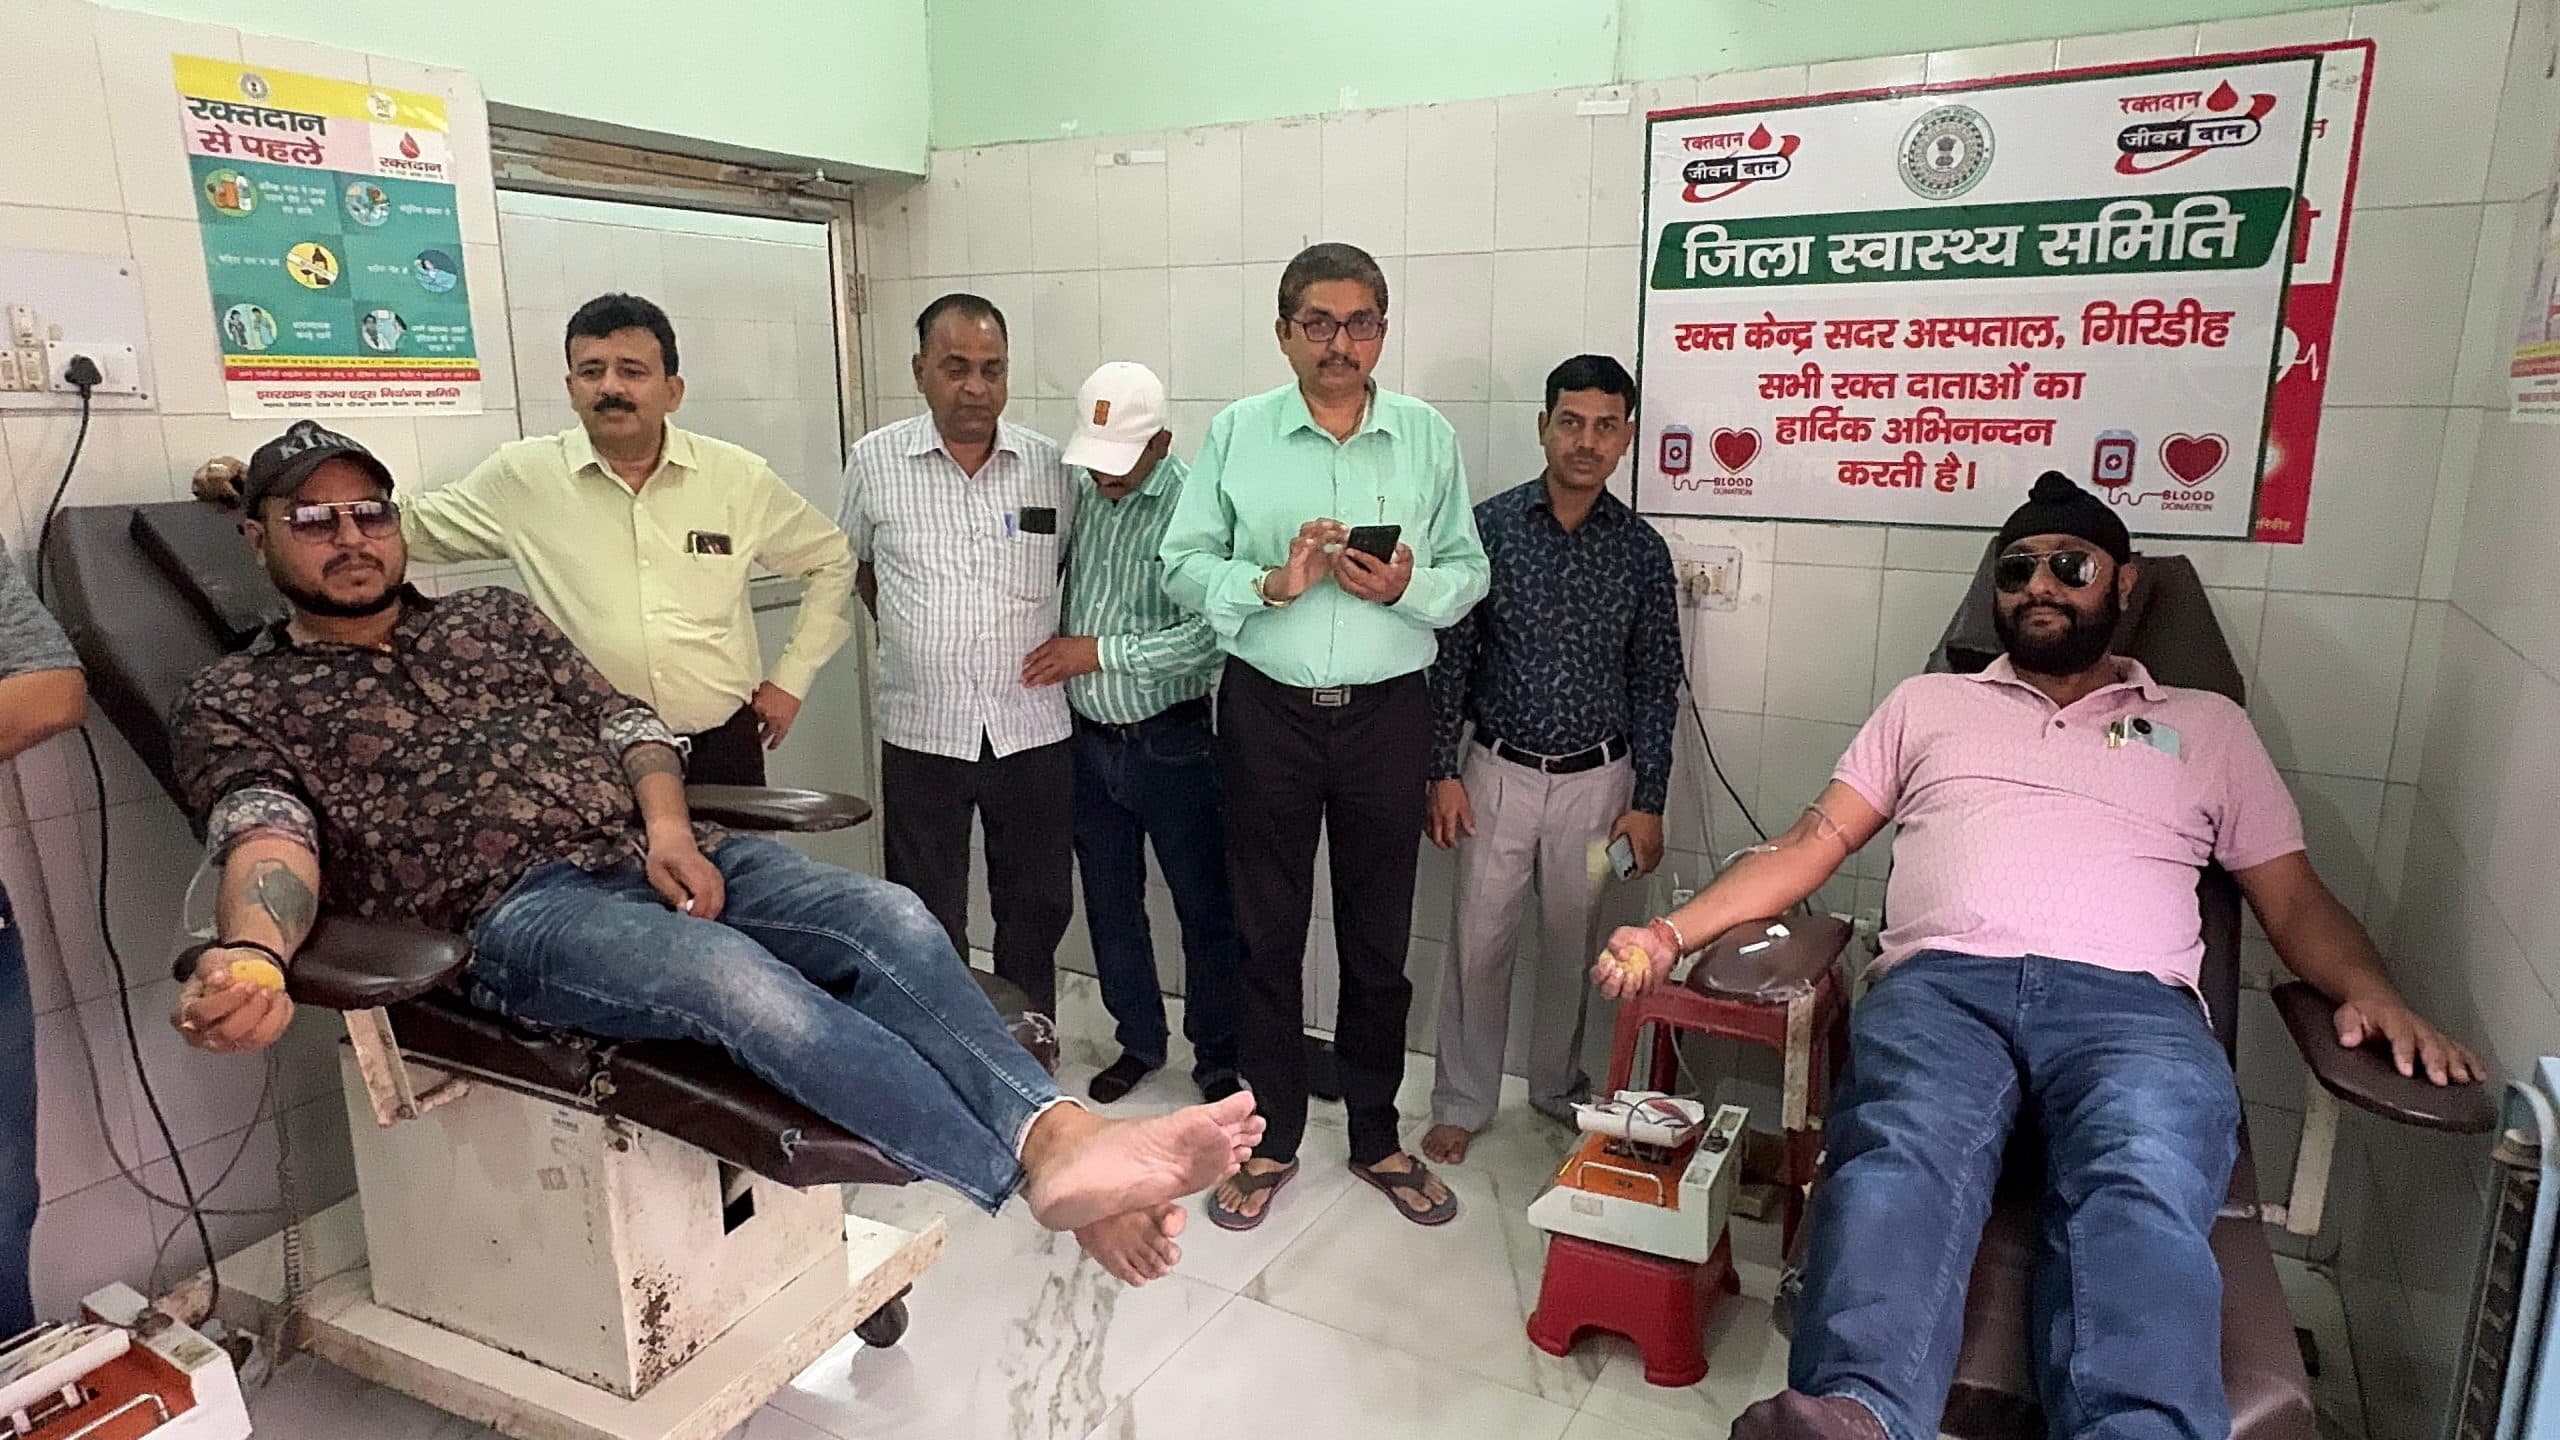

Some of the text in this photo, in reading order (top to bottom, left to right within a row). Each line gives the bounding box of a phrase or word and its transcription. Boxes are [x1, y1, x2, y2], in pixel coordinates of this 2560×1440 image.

[2118, 90, 2203, 115] रक्तदान
[184, 95, 327, 136] रक्तदान
[197, 124, 326, 166] से पहले
[1681, 131, 1745, 152] रक्तदान
[2123, 123, 2247, 147] जीवन दान
[378, 156, 442, 173] रक्तदान
[1686, 159, 1779, 181] जीवन दान
[1682, 223, 1815, 280] जिला
[1827, 224, 2025, 276] स्वास्थ्य
[2038, 195, 2247, 267] समिति
[1674, 297, 2236, 356] रक्त केन्द्र सदर अस्पताल, गिरिडीह
[1757, 361, 2087, 401] सभी रक्त दाताओं का
[1775, 405, 2057, 447] हार्दिक अभिनन्दन
[1713, 477, 1753, 487] BLOOD
[1837, 450, 1926, 489] करती
[2160, 501, 2213, 512] DONATION
[2161, 489, 2215, 501] BLOOD
